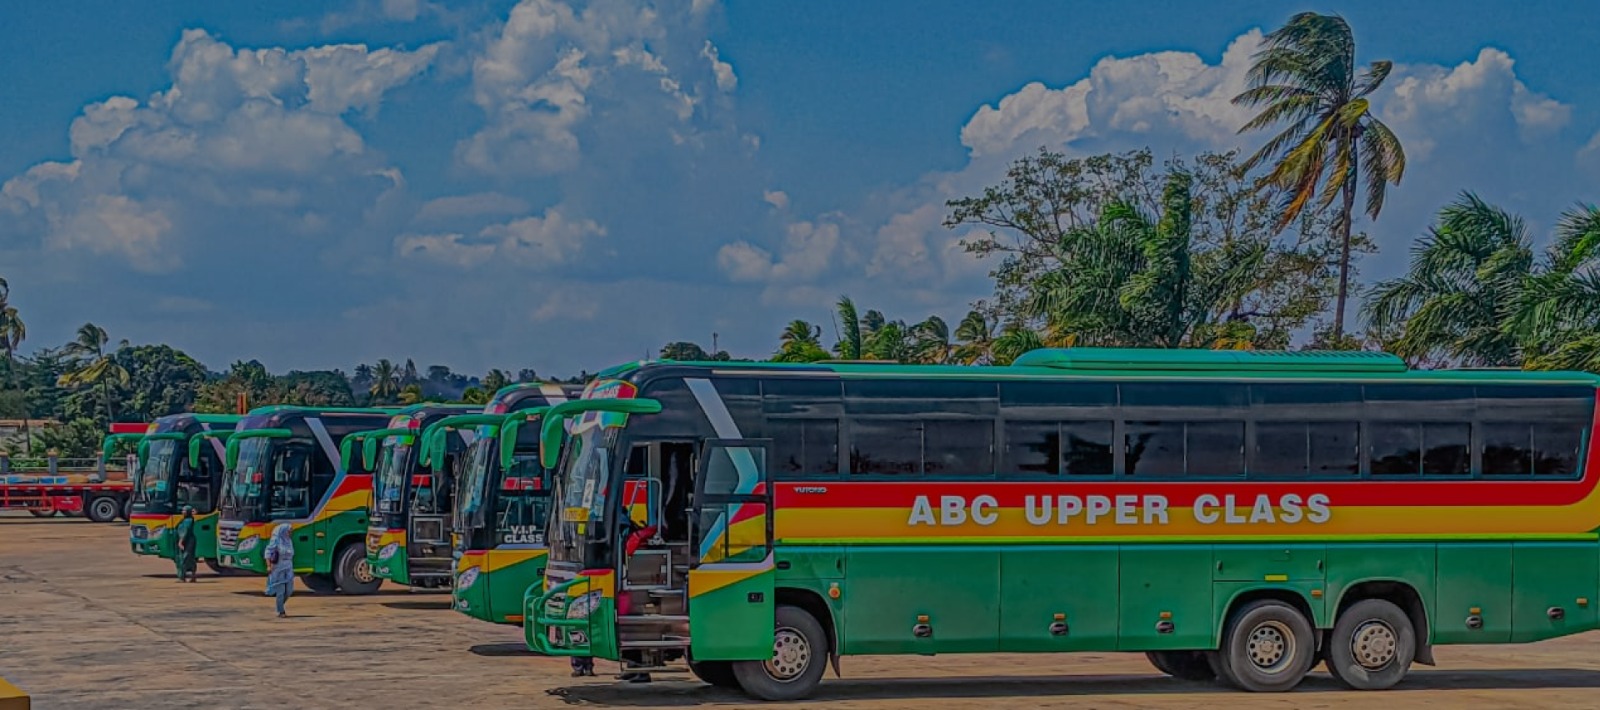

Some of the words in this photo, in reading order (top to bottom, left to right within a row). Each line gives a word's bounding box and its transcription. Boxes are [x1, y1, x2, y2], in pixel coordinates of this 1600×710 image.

[907, 494, 999, 526] ABC
[1024, 494, 1169, 525] UPPER
[1193, 493, 1331, 524] CLASS
[503, 534, 543, 544] CLASS
